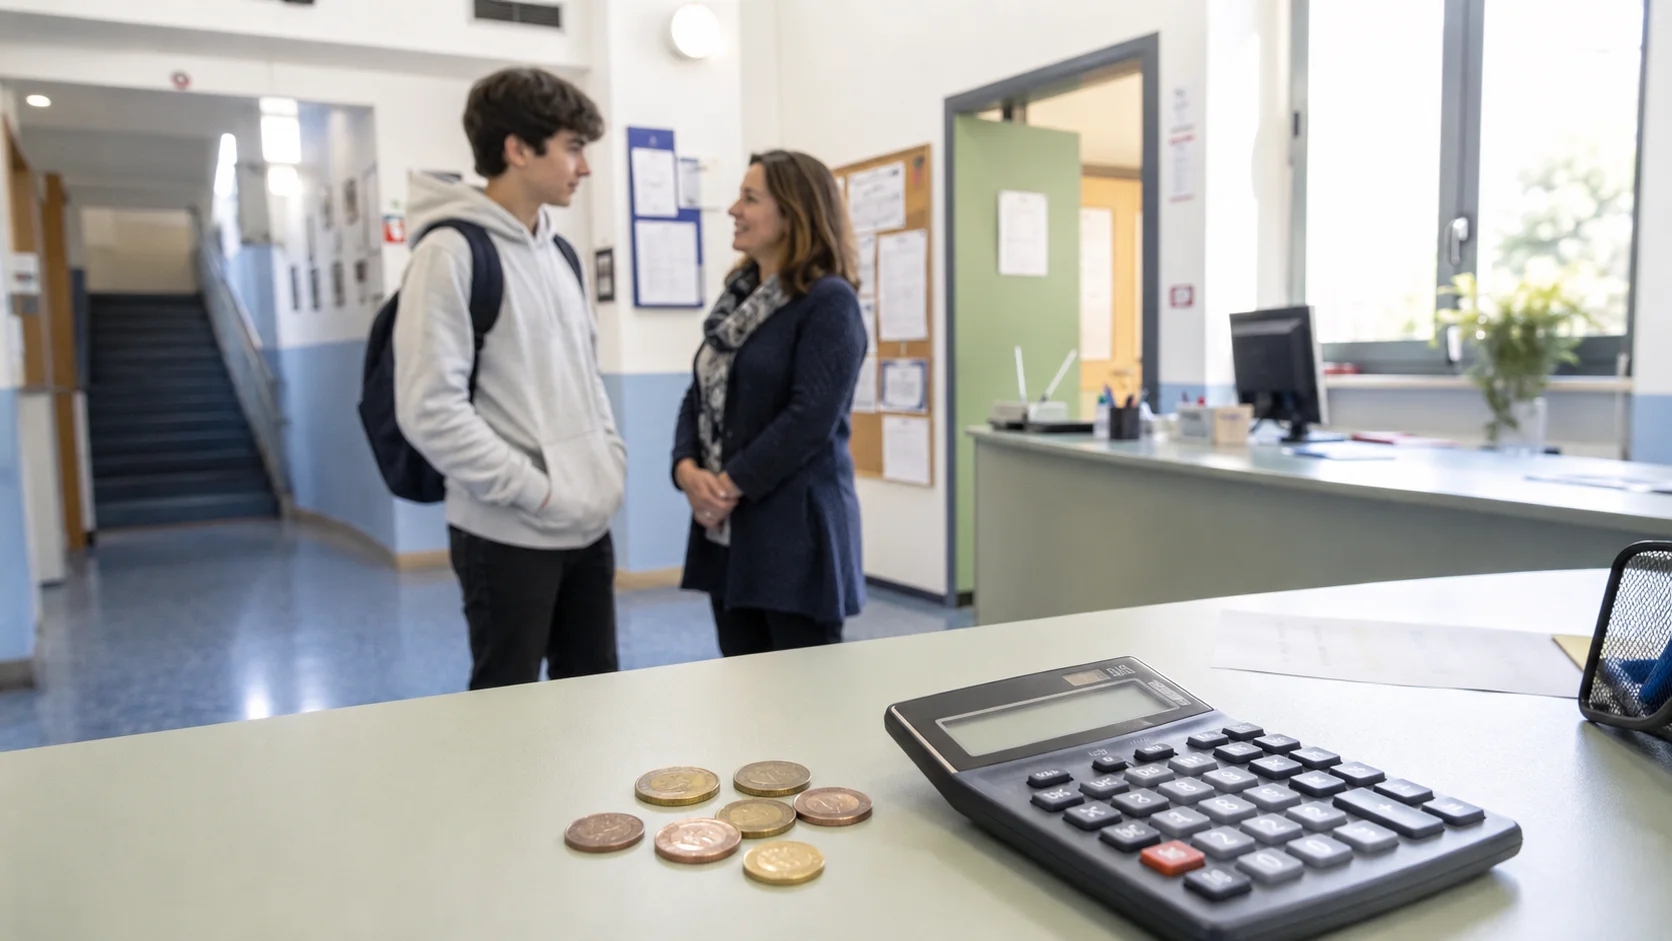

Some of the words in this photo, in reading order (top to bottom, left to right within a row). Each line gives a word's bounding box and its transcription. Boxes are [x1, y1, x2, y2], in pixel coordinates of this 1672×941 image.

[1175, 781, 1197, 792] 8
[1215, 799, 1239, 810] 8
[1211, 831, 1238, 845] 2
